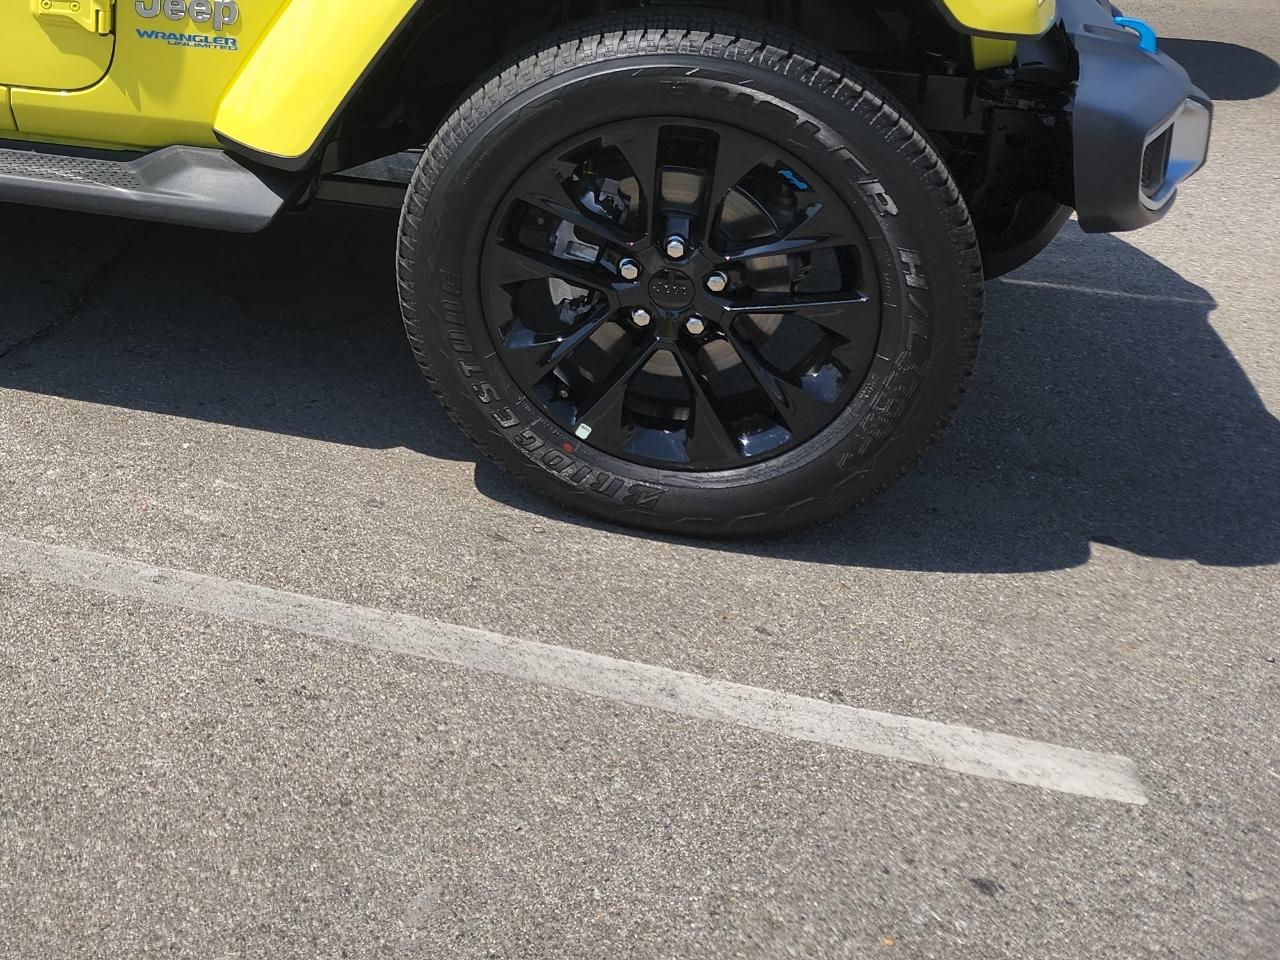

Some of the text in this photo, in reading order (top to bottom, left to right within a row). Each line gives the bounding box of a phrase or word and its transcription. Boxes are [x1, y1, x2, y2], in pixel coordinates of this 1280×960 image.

[135, 28, 238, 47] WRANGLER
[167, 40, 239, 51] UNLIMITED
[439, 268, 668, 510] BRIDGESTONE
